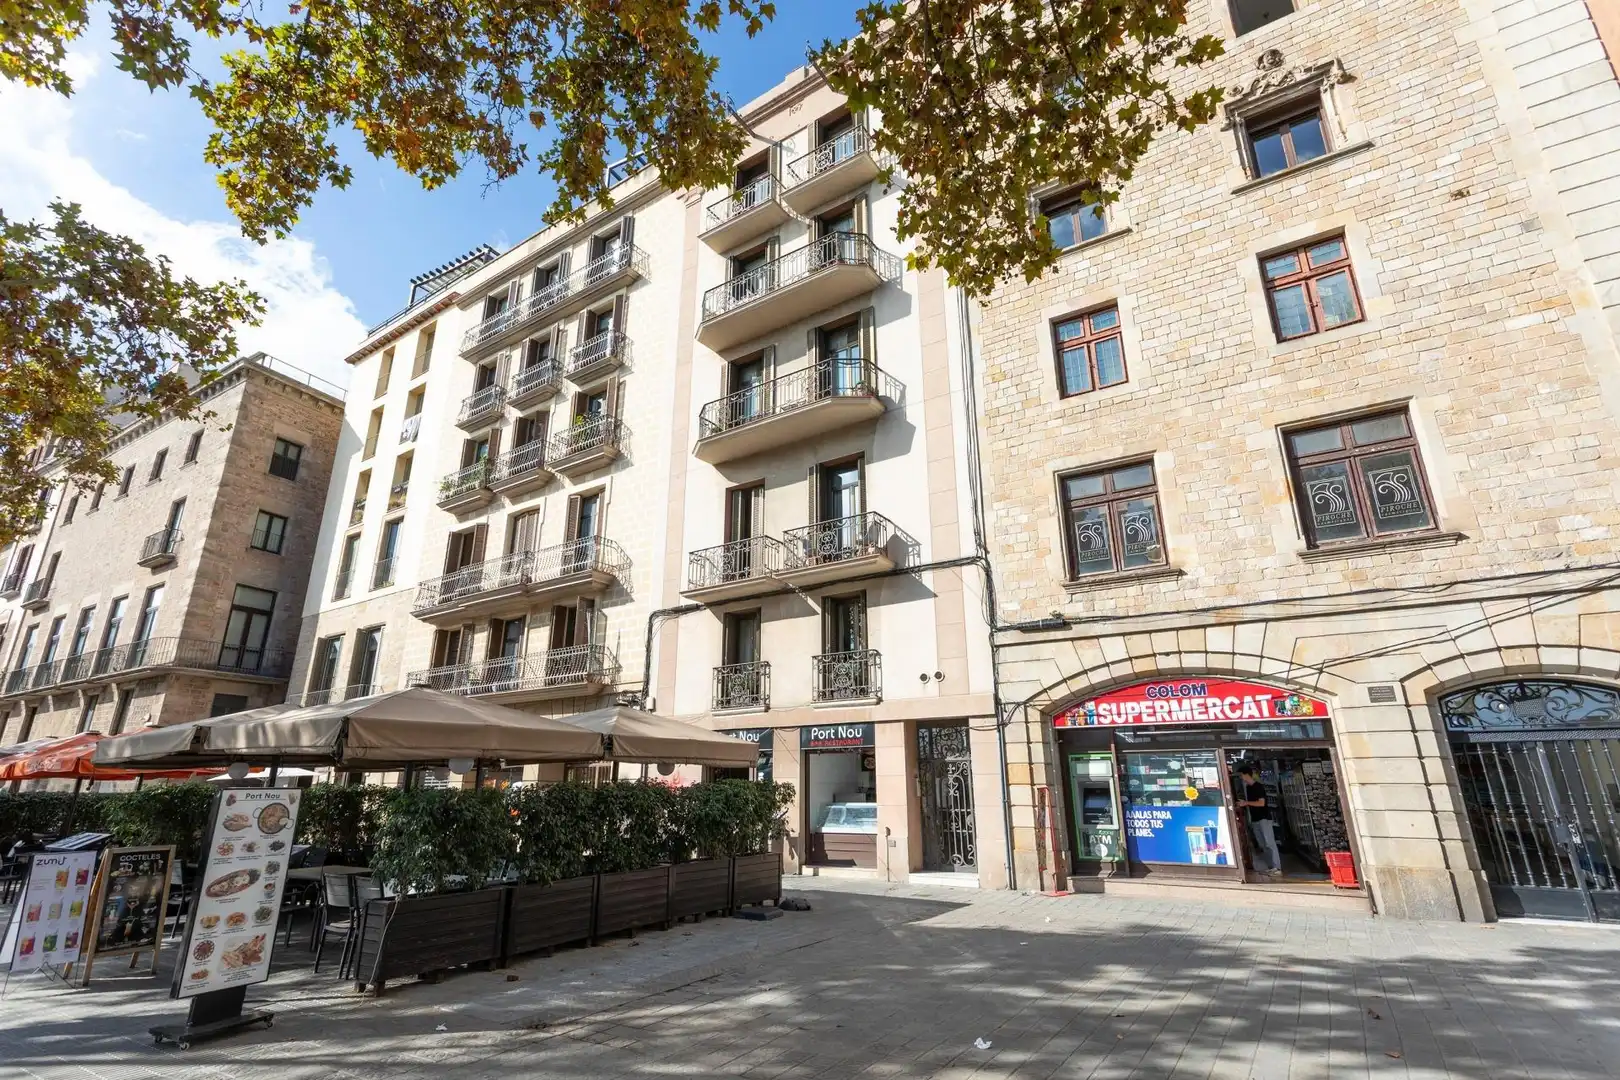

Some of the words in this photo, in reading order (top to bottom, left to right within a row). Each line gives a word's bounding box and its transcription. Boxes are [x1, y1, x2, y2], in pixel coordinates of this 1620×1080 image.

[1380, 501, 1418, 513] PIROCHE
[1316, 511, 1352, 522] PIROCHE
[1147, 683, 1207, 698] COLOM
[1100, 694, 1272, 724] SUPERMERCAT
[740, 731, 760, 742] Nou
[811, 727, 835, 740] Port
[838, 725, 863, 738] Nou
[1152, 810, 1172, 820] PARA
[1127, 819, 1150, 828] TODOS
[1150, 820, 1164, 829] TUS
[1089, 834, 1112, 845] ATM
[120, 853, 161, 861] COCTELES
